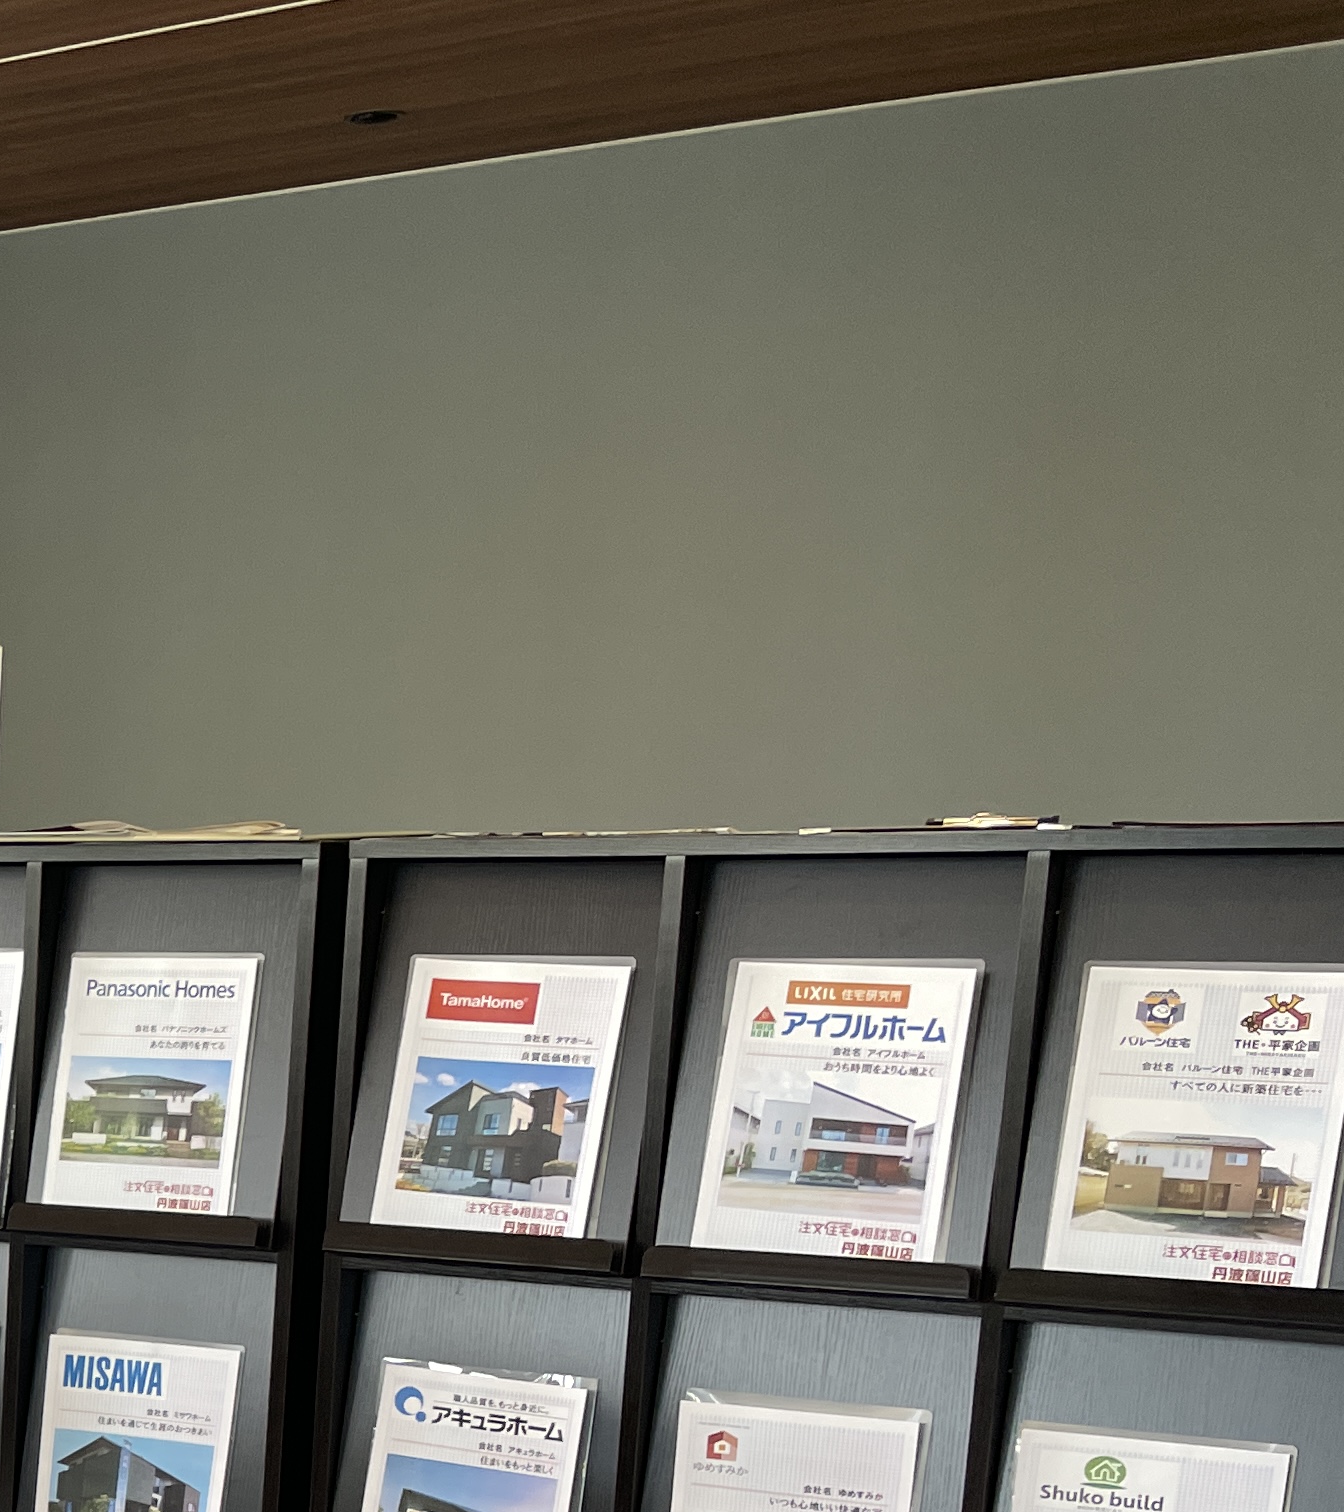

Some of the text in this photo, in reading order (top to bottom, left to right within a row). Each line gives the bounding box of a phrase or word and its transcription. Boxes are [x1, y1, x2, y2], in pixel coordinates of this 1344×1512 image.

[86, 979, 237, 999] Panasonic Homes
[795, 986, 903, 1003] LIXIL 住宅研究所
[440, 992, 525, 1010] TamaHome
[781, 1011, 946, 1043] アイフルホーム
[1141, 1061, 1174, 1072] 会社名
[62, 1354, 162, 1397] MISAWA
[431, 1405, 564, 1442] アキュラホーム
[692, 1461, 749, 1477] ゆめすみか
[838, 1488, 884, 1501] ゆめすみか
[1040, 1484, 1104, 1506] Shuko
[1109, 1491, 1165, 1512] build
